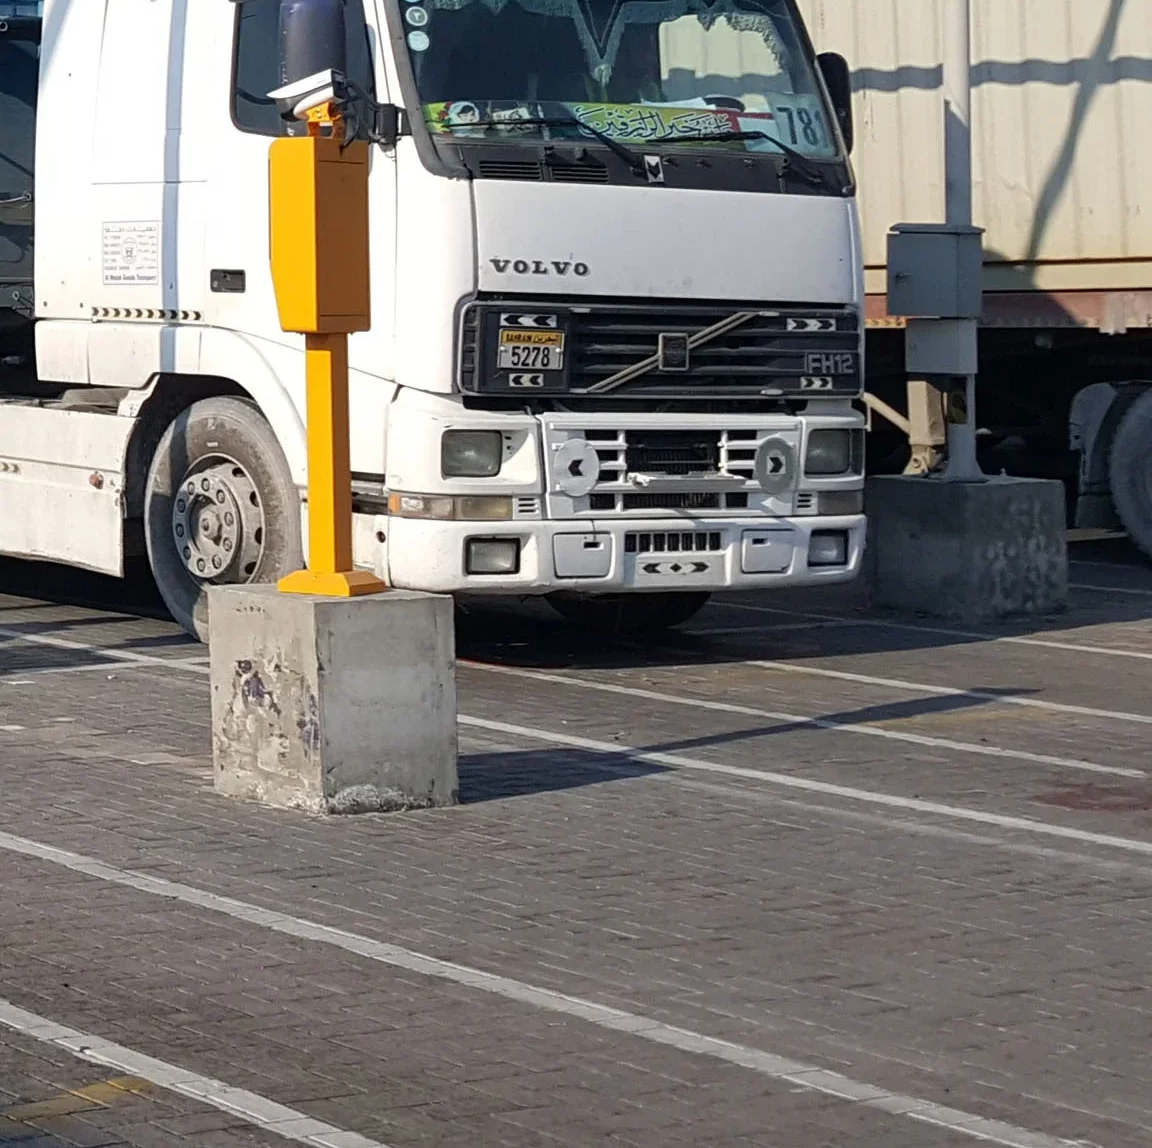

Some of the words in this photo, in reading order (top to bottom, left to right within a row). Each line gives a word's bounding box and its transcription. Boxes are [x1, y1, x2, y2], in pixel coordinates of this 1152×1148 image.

[489, 258, 589, 276] VOLVO
[511, 345, 550, 368] 5278
[808, 353, 854, 374] FH12
